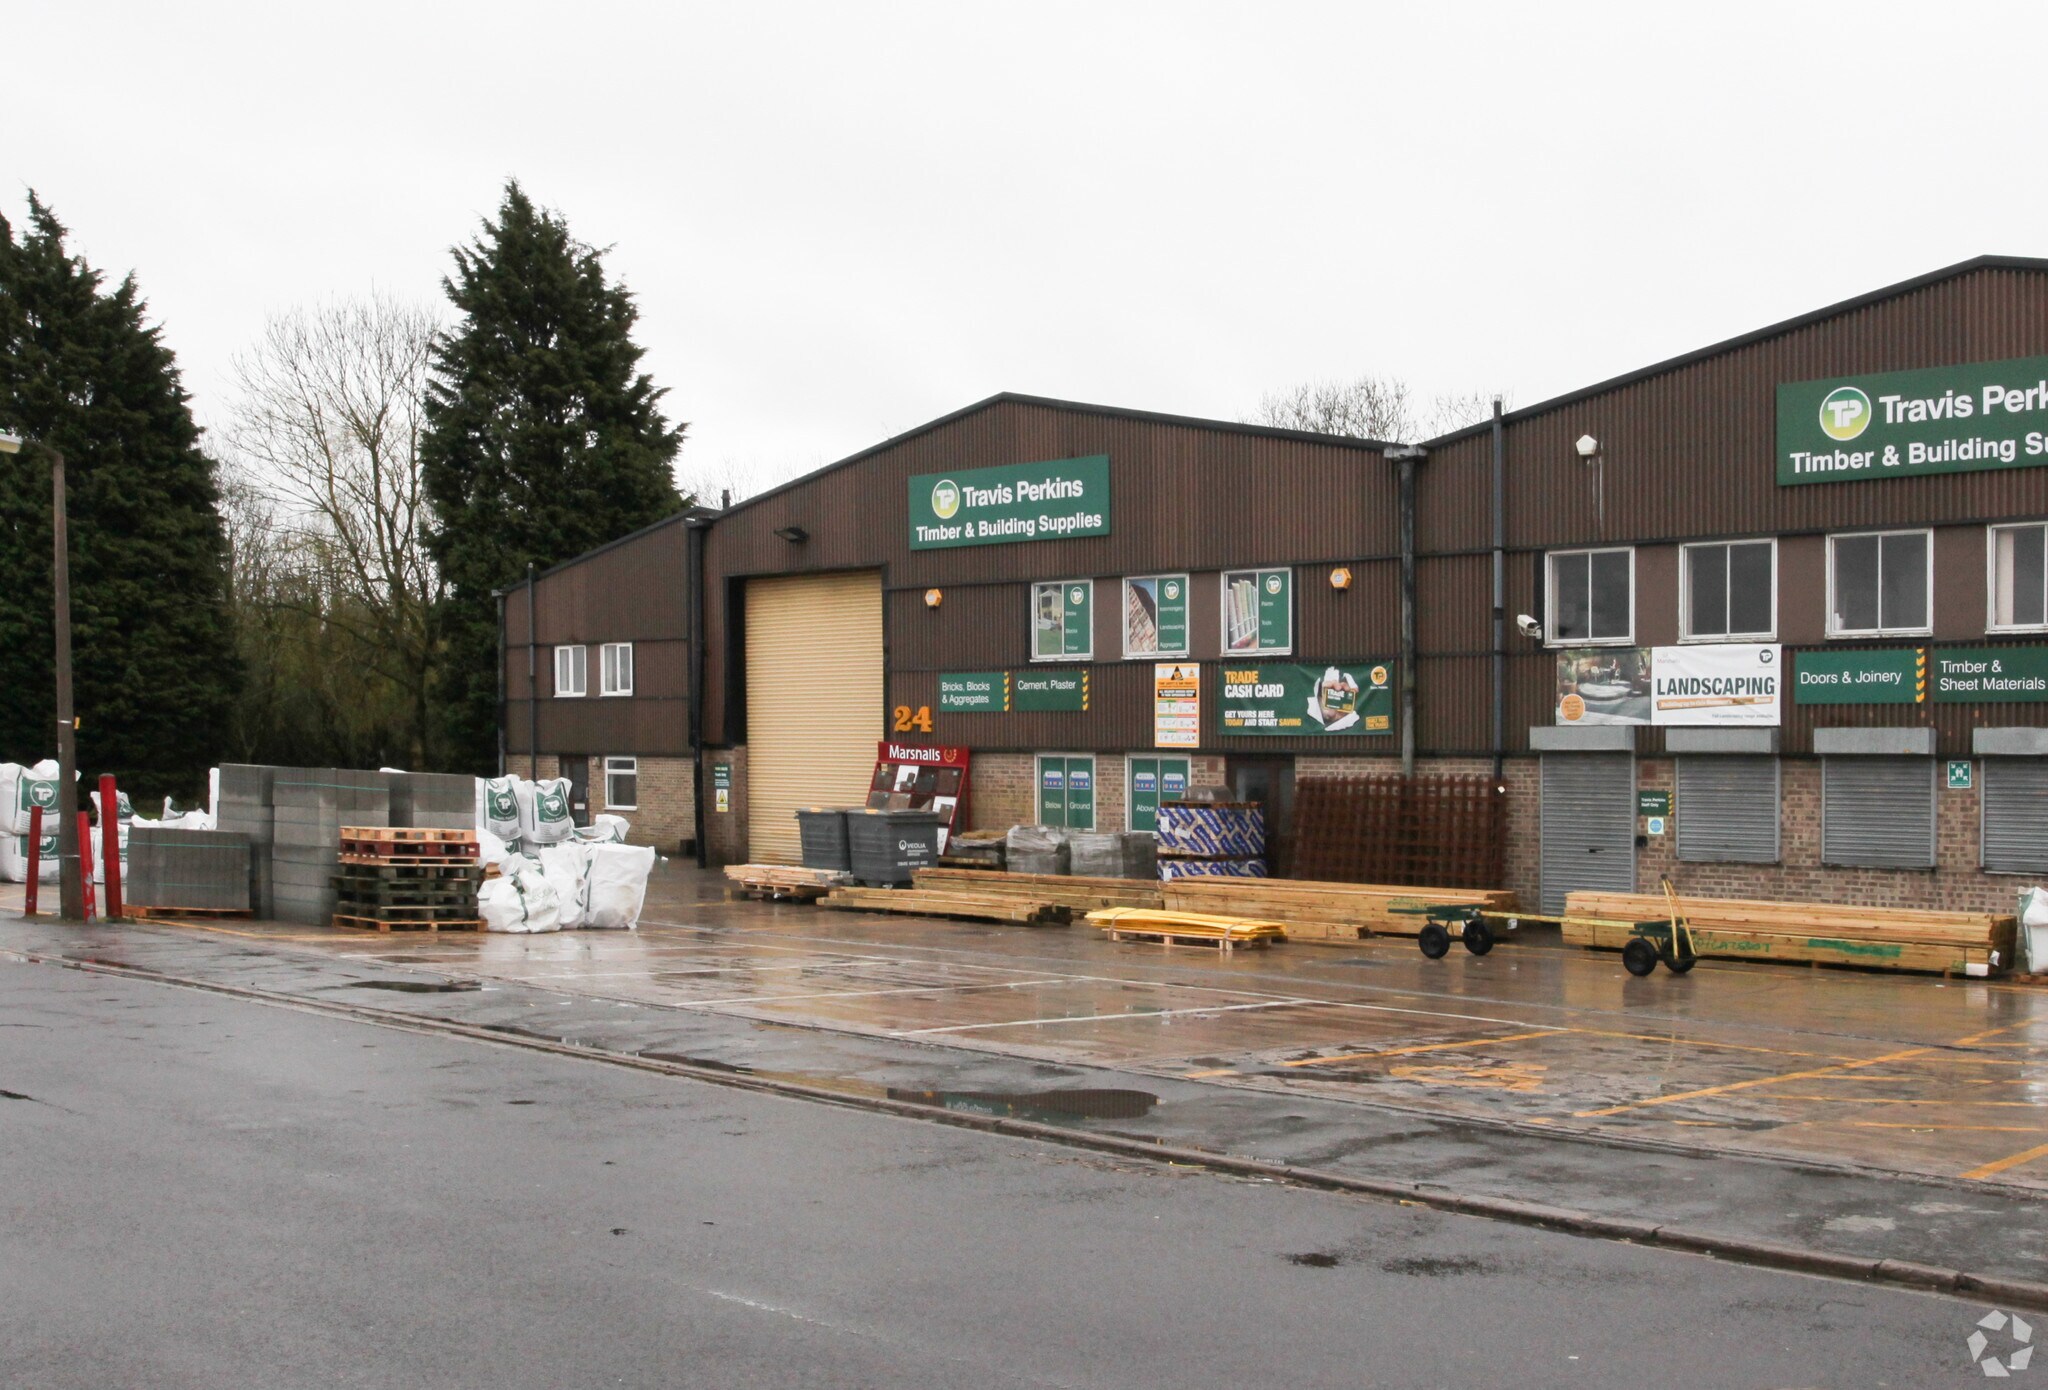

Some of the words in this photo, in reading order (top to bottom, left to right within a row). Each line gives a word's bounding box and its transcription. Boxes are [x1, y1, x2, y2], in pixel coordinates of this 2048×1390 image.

[1828, 399, 1862, 427] TP
[1878, 390, 1974, 424] Travis
[1790, 450, 1874, 473] Timber
[1882, 445, 1900, 466] &
[1908, 438, 2016, 463] Building
[2025, 432, 2048, 455] S
[936, 488, 956, 509] TP
[962, 484, 1012, 508] Travis
[1016, 478, 1084, 502] Perkins
[916, 524, 961, 542] Timber
[965, 522, 974, 538] &
[978, 520, 1035, 536] Building
[1038, 512, 1102, 534] Supplies
[1761, 652, 1772, 662] TP
[1940, 660, 1986, 674] Timber
[1991, 660, 2002, 673] &
[1224, 670, 1258, 684] TRADE
[1800, 672, 1838, 684] Doors
[1842, 671, 1852, 683] &
[1855, 670, 1902, 685] Joinery
[1940, 678, 1978, 691] Sheet
[1982, 677, 2046, 690] Materials
[942, 682, 964, 692] Bricks,
[966, 682, 990, 692] Blocks
[1018, 680, 1048, 692] Cement,
[1050, 680, 1076, 690] Plaster
[1224, 684, 1252, 698] CASH
[1254, 684, 1284, 698] CARD
[1657, 676, 1775, 696] LANDSCAPING
[942, 694, 948, 704] &
[949, 694, 990, 706] Aggregates
[894, 705, 933, 732] 24
[1224, 710, 1236, 718] GET
[1237, 710, 1256, 718] YOURS
[1258, 710, 1275, 718] HERE
[1225, 718, 1244, 726] TODAY
[1244, 718, 1257, 726] AND
[1258, 718, 1278, 726] START
[1279, 718, 1302, 726] SAVING
[35, 788, 54, 801] TP
[1045, 801, 1062, 809] Below
[1070, 802, 1091, 810] Ground
[1136, 804, 1155, 812] Above
